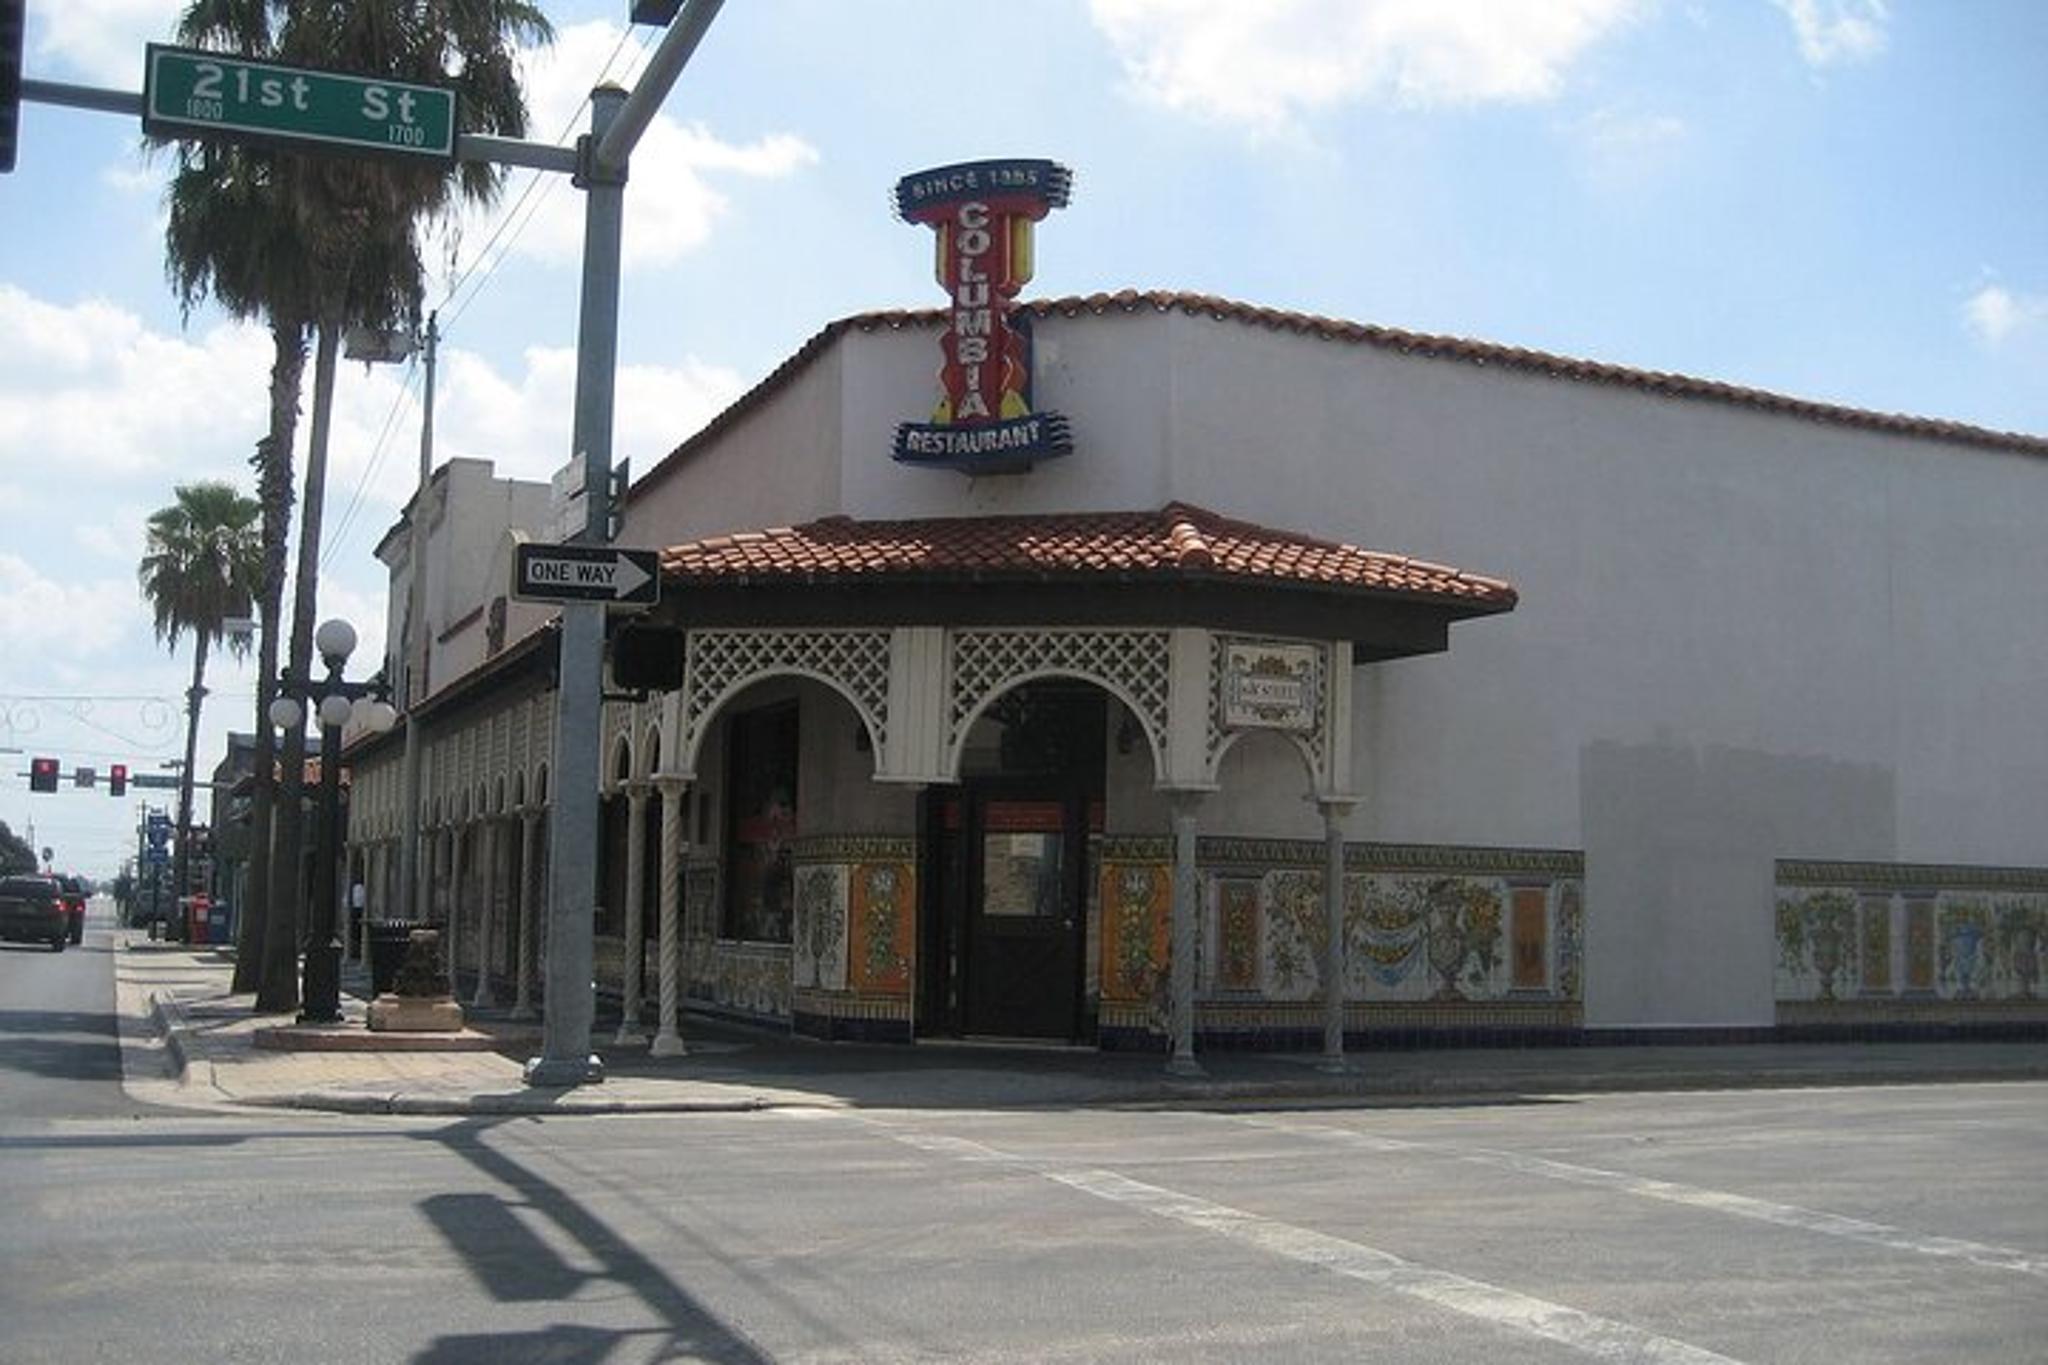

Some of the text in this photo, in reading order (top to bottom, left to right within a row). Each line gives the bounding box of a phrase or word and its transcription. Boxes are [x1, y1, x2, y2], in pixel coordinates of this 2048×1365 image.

[193, 64, 415, 123] 21st St
[388, 122, 424, 147] 1700
[912, 171, 978, 198] SINCE
[956, 203, 990, 418] COLUMBIA
[906, 420, 1040, 453] RESTAURANT
[531, 562, 616, 583] ONE WAY
